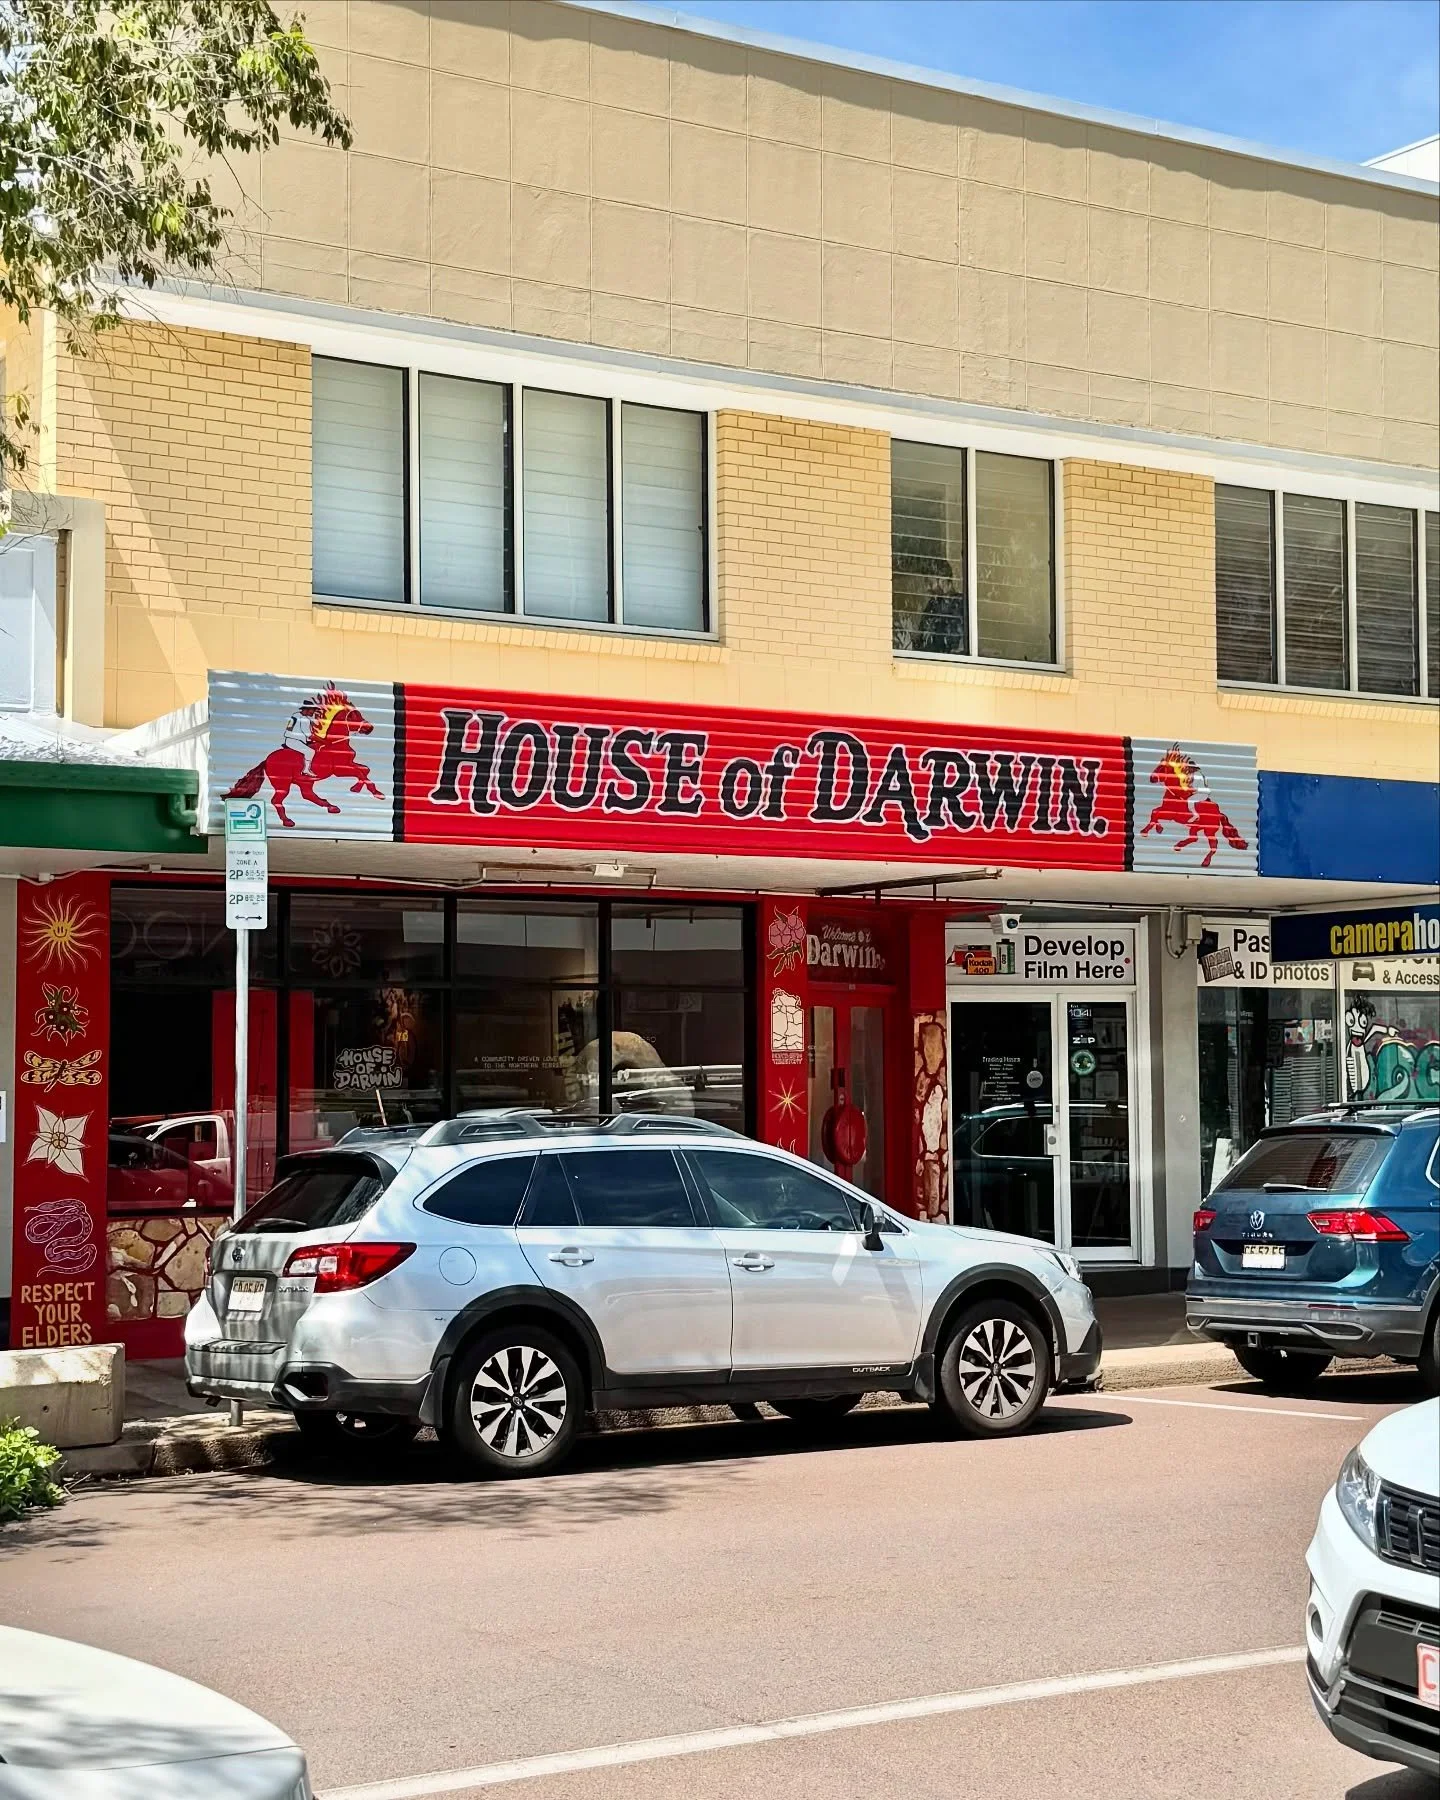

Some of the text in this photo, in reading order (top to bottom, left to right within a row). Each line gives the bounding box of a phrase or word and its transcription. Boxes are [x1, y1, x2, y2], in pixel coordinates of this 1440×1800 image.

[428, 707, 1109, 843] HOUSE of DARWIN.
[229, 869, 244, 880] 2P
[229, 894, 244, 905] 2P
[1024, 935, 1125, 960] Develop
[968, 959, 993, 967] Kodak
[1024, 961, 1125, 979] Film Here
[1233, 961, 1330, 984] & ID photos
[1382, 970, 1392, 985] &
[337, 1047, 395, 1068] HOUSE
[355, 1063, 375, 1075] OF
[20, 1281, 96, 1304] RESPECT
[34, 1302, 83, 1325] YOUR
[22, 1322, 93, 1348] ELDERS
[852, 1365, 891, 1373] OUTBACK
